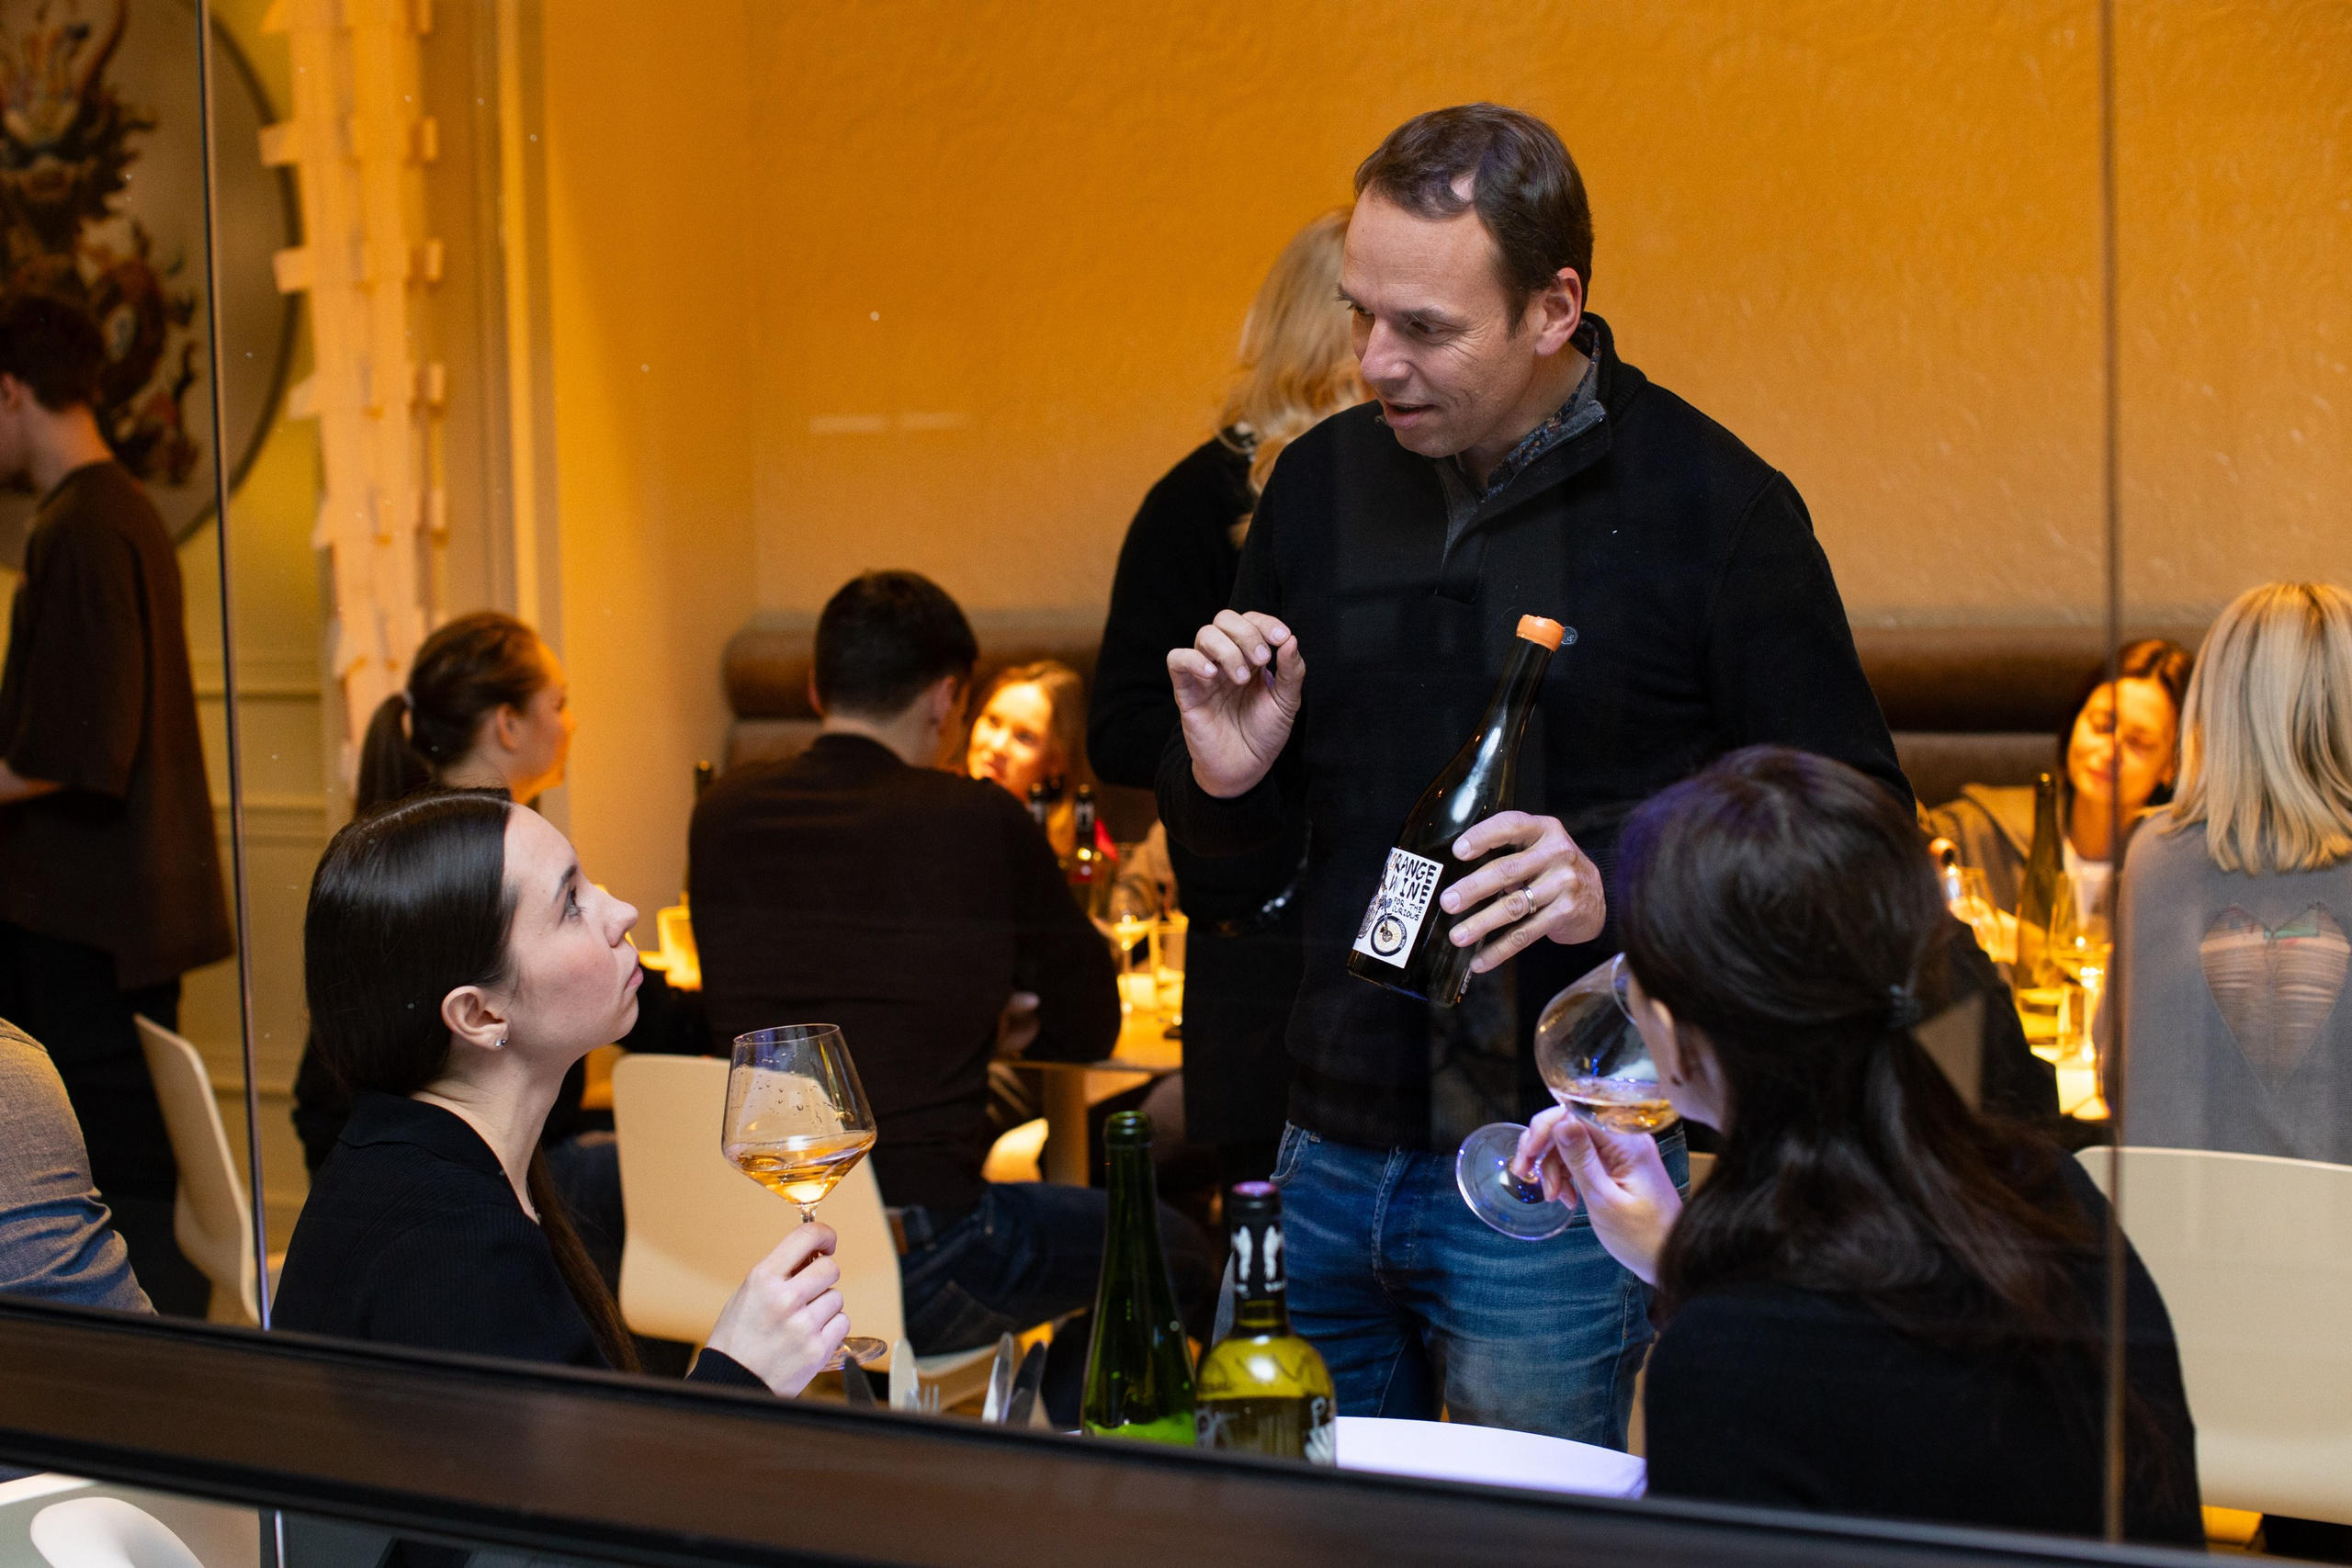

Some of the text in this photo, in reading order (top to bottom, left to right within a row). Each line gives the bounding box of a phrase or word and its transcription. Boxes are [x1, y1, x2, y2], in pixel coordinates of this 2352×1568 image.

[1389, 853, 1437, 885] ORANGE
[1389, 875, 1430, 904] WINE
[1392, 906, 1420, 921] CURIOUS
[1394, 897, 1423, 914] FOR THE
